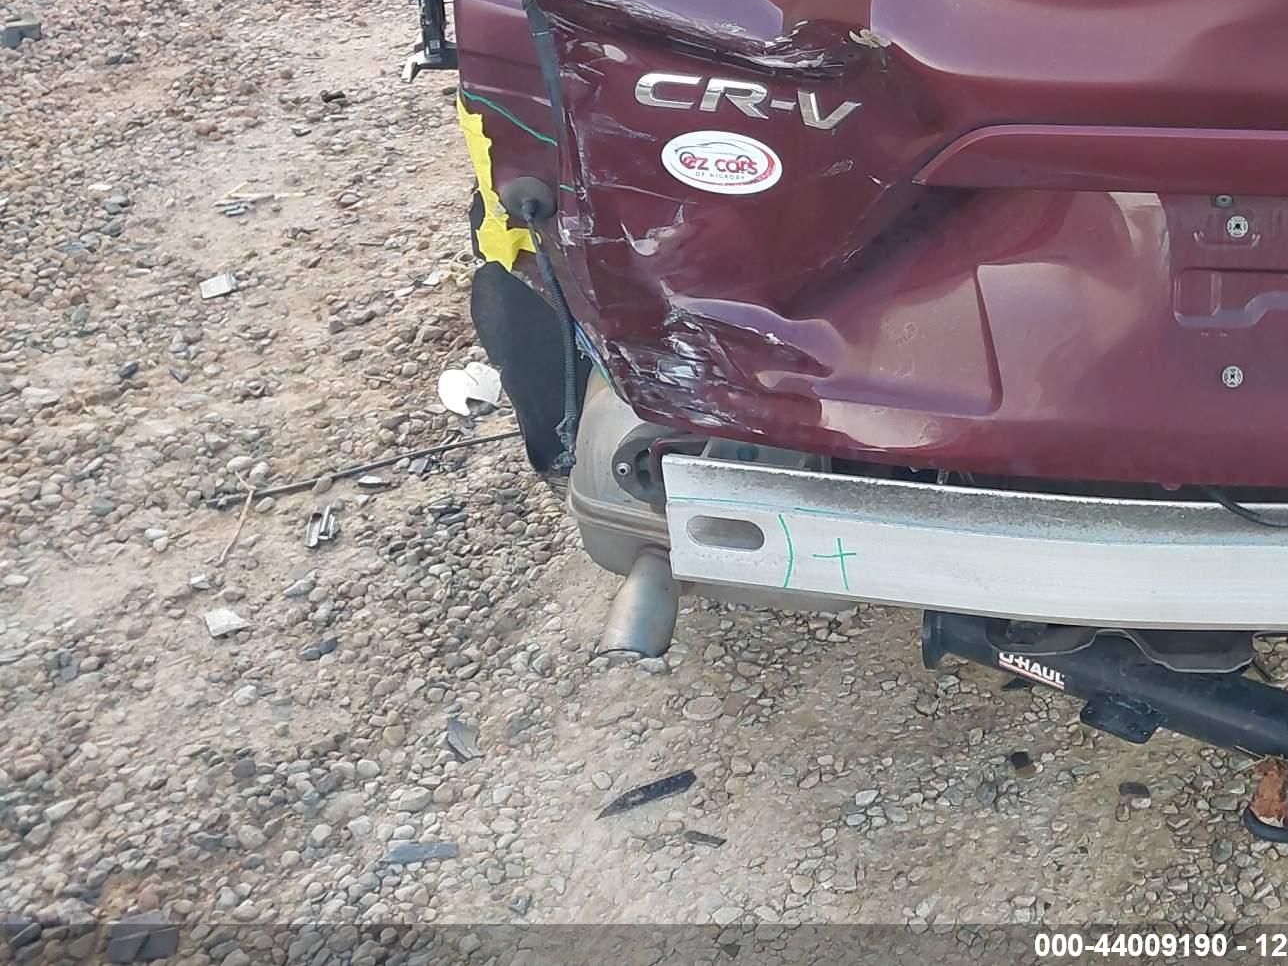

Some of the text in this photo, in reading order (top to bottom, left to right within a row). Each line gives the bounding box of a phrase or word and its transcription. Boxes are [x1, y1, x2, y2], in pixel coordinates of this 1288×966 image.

[634, 73, 862, 129] CR-V
[714, 157, 758, 175] cars
[998, 652, 1065, 686] U-HAUL
